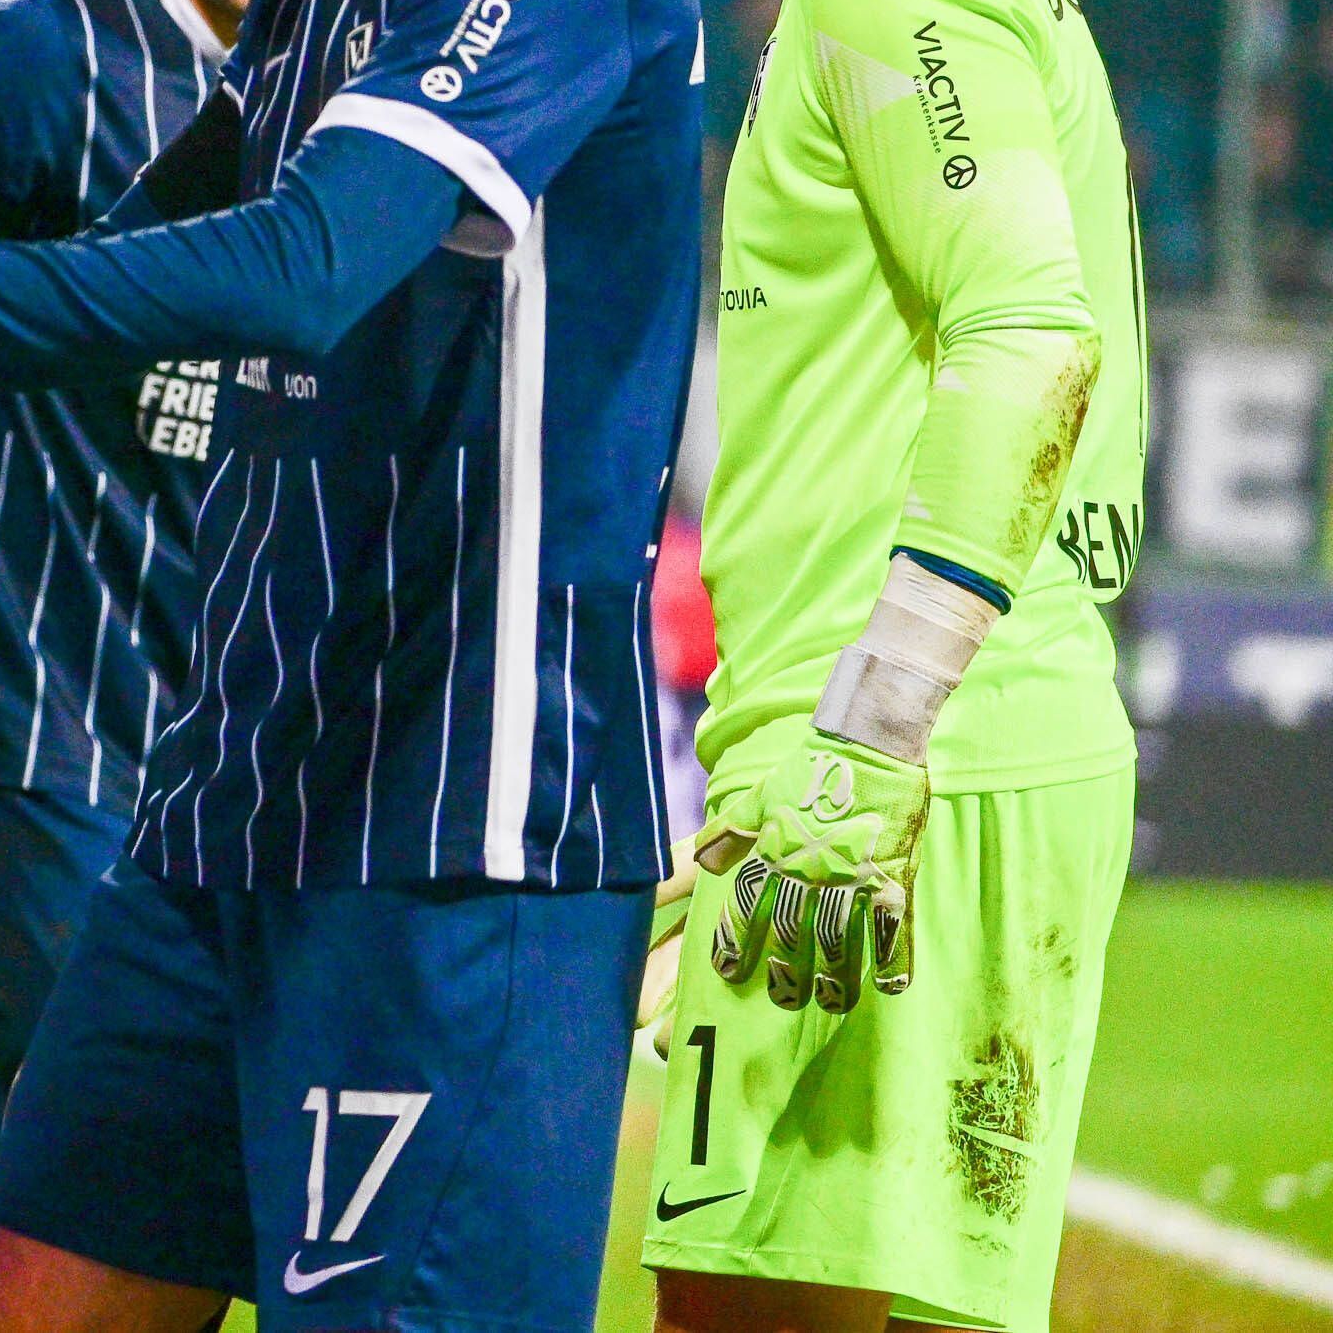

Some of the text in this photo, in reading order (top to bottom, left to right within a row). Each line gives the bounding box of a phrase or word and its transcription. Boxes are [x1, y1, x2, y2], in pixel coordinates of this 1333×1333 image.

[912, 74, 942, 155] Krankenkasse
[913, 20, 970, 142] VIACTIV
[686, 1024, 718, 1167] 1
[301, 1086, 433, 1243] 17
